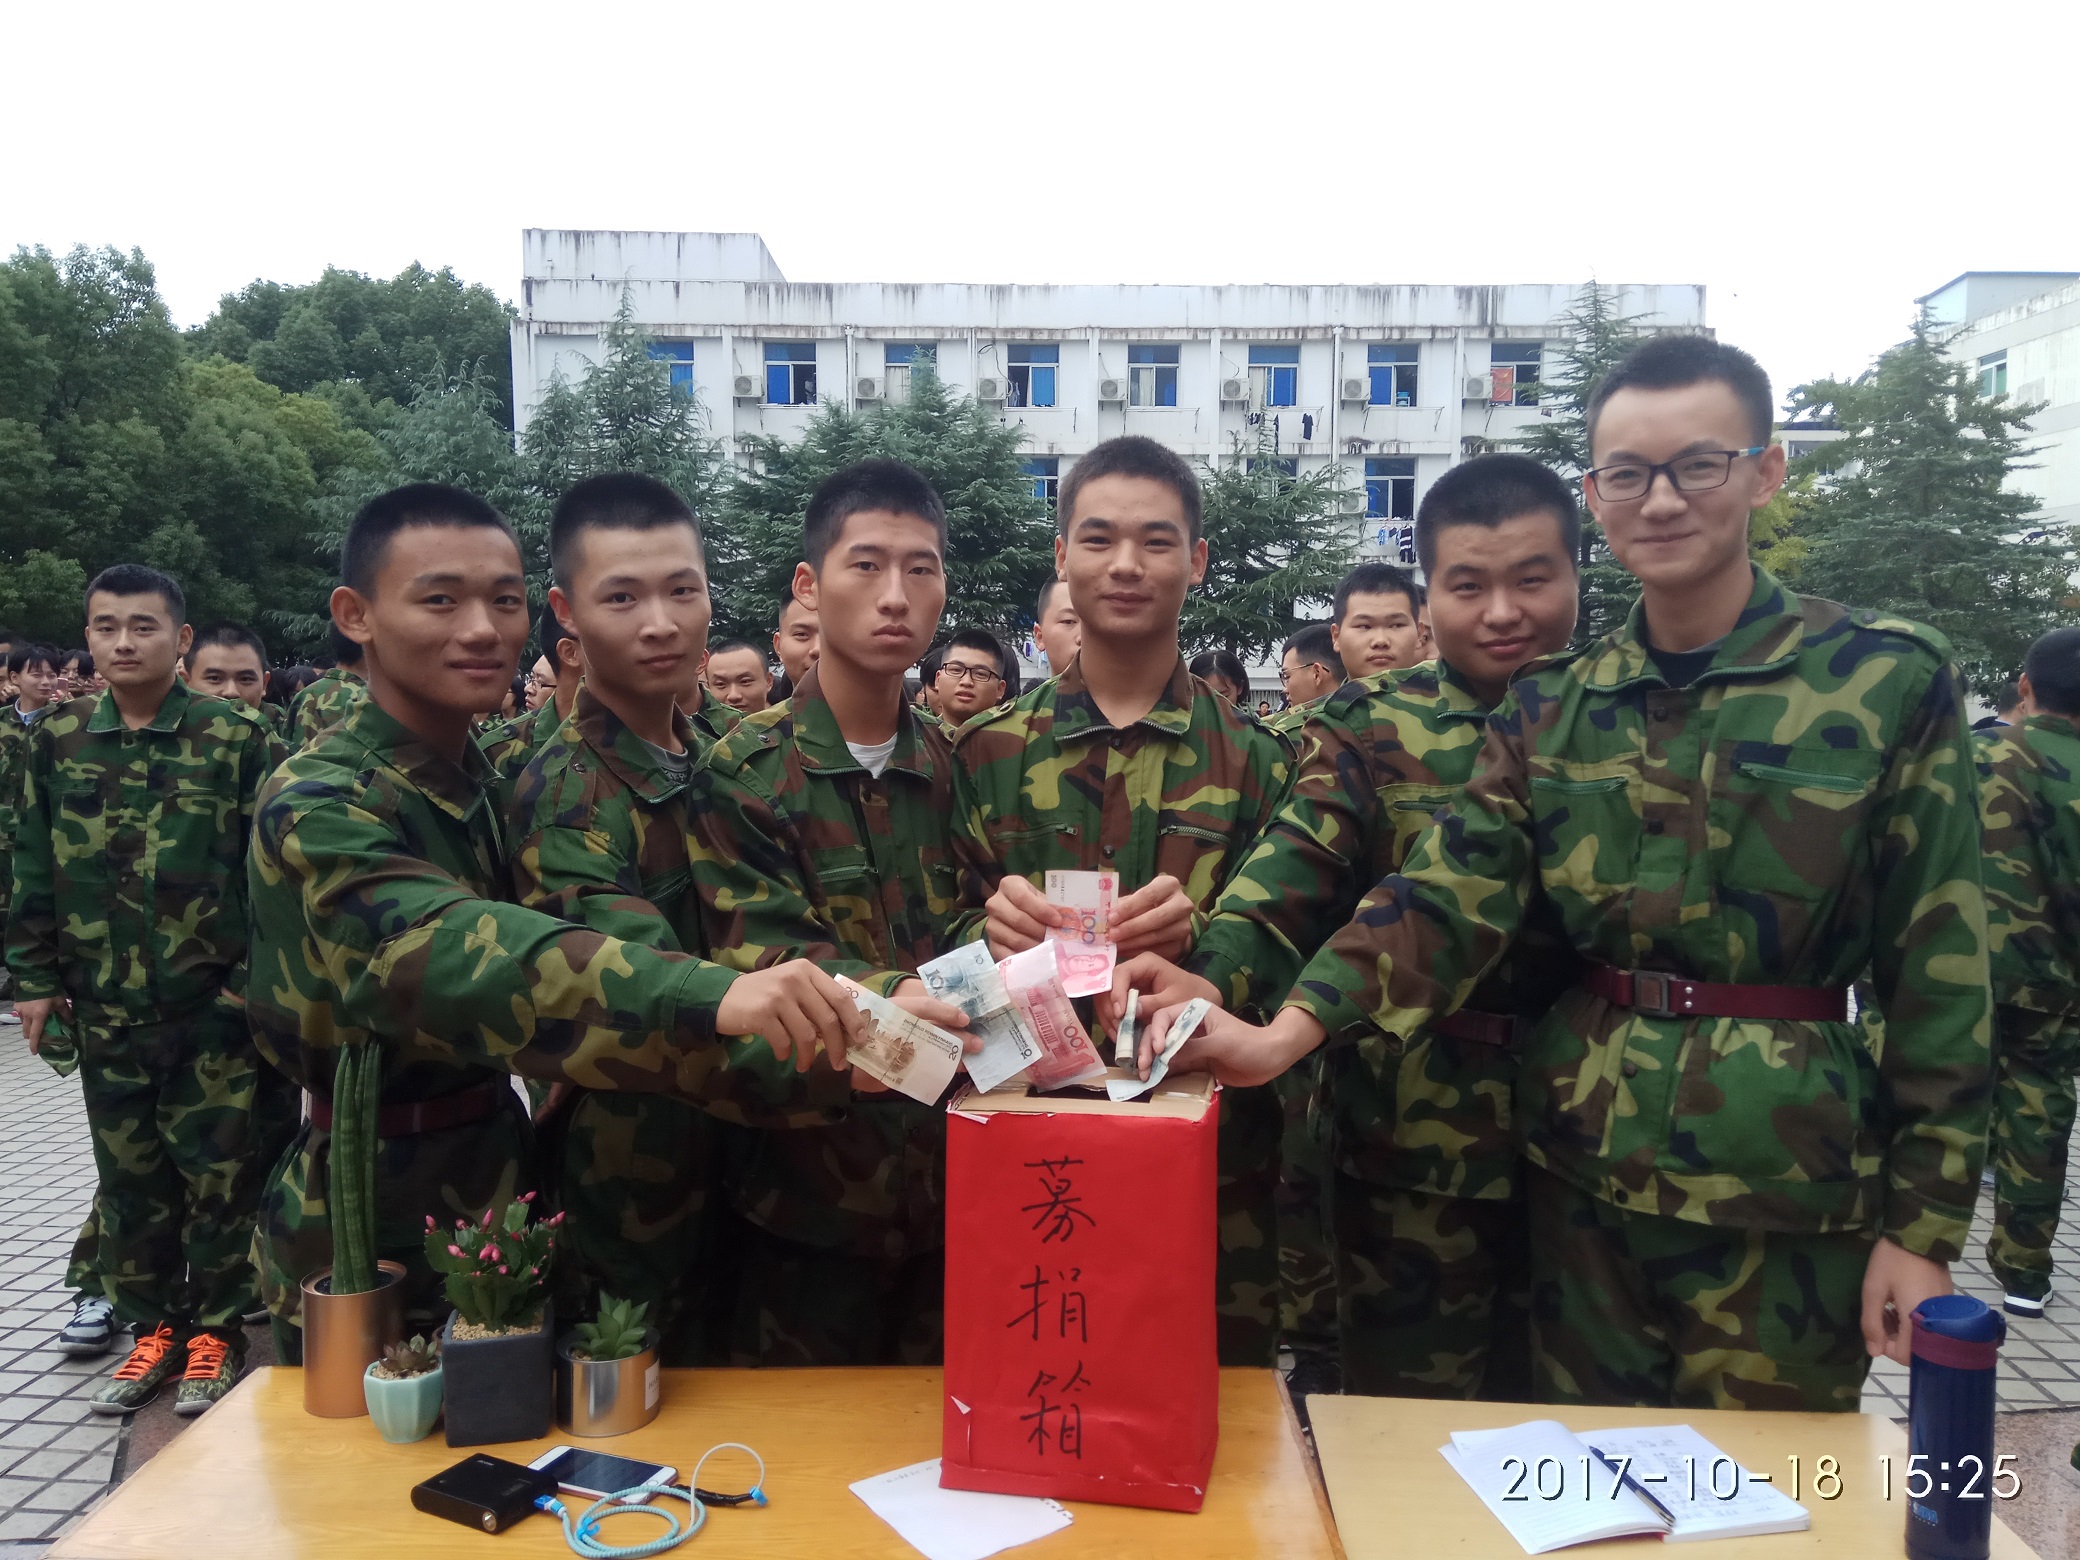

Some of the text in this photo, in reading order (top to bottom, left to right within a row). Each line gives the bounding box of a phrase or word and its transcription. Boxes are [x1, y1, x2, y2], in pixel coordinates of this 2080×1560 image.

[1081, 909, 1096, 945] 100
[974, 954, 984, 965] 10
[924, 969, 945, 990] 10
[1064, 1025, 1089, 1053] 100
[949, 1045, 959, 1061] 20
[1020, 1048, 1033, 1060] 10
[1007, 1155, 1096, 1460] 募捐箱
